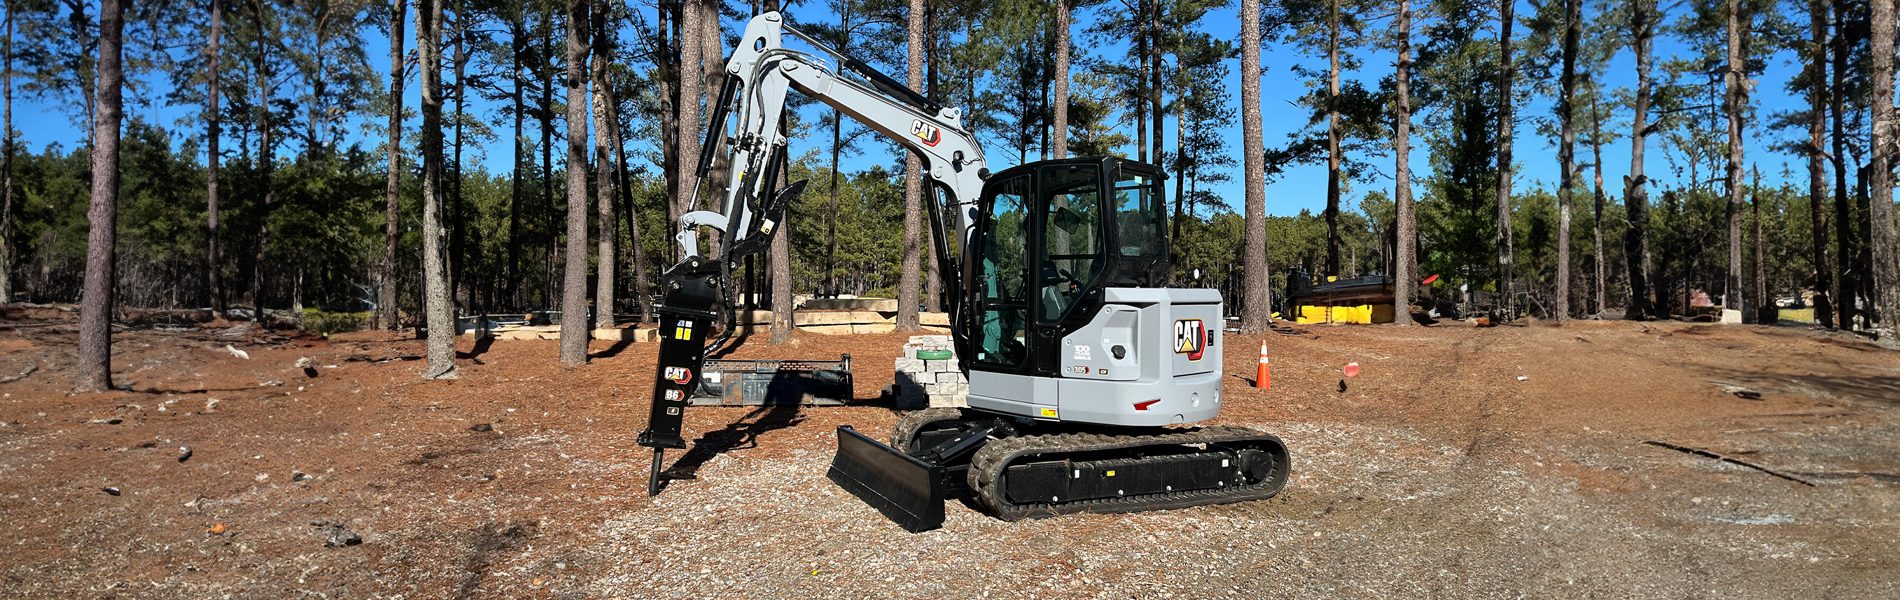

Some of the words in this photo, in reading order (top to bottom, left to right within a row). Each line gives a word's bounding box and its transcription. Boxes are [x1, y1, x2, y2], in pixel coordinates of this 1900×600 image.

[911, 119, 936, 141] CAT
[1174, 320, 1200, 353] CAT
[664, 367, 686, 380] CAT
[666, 388, 679, 400] B6
